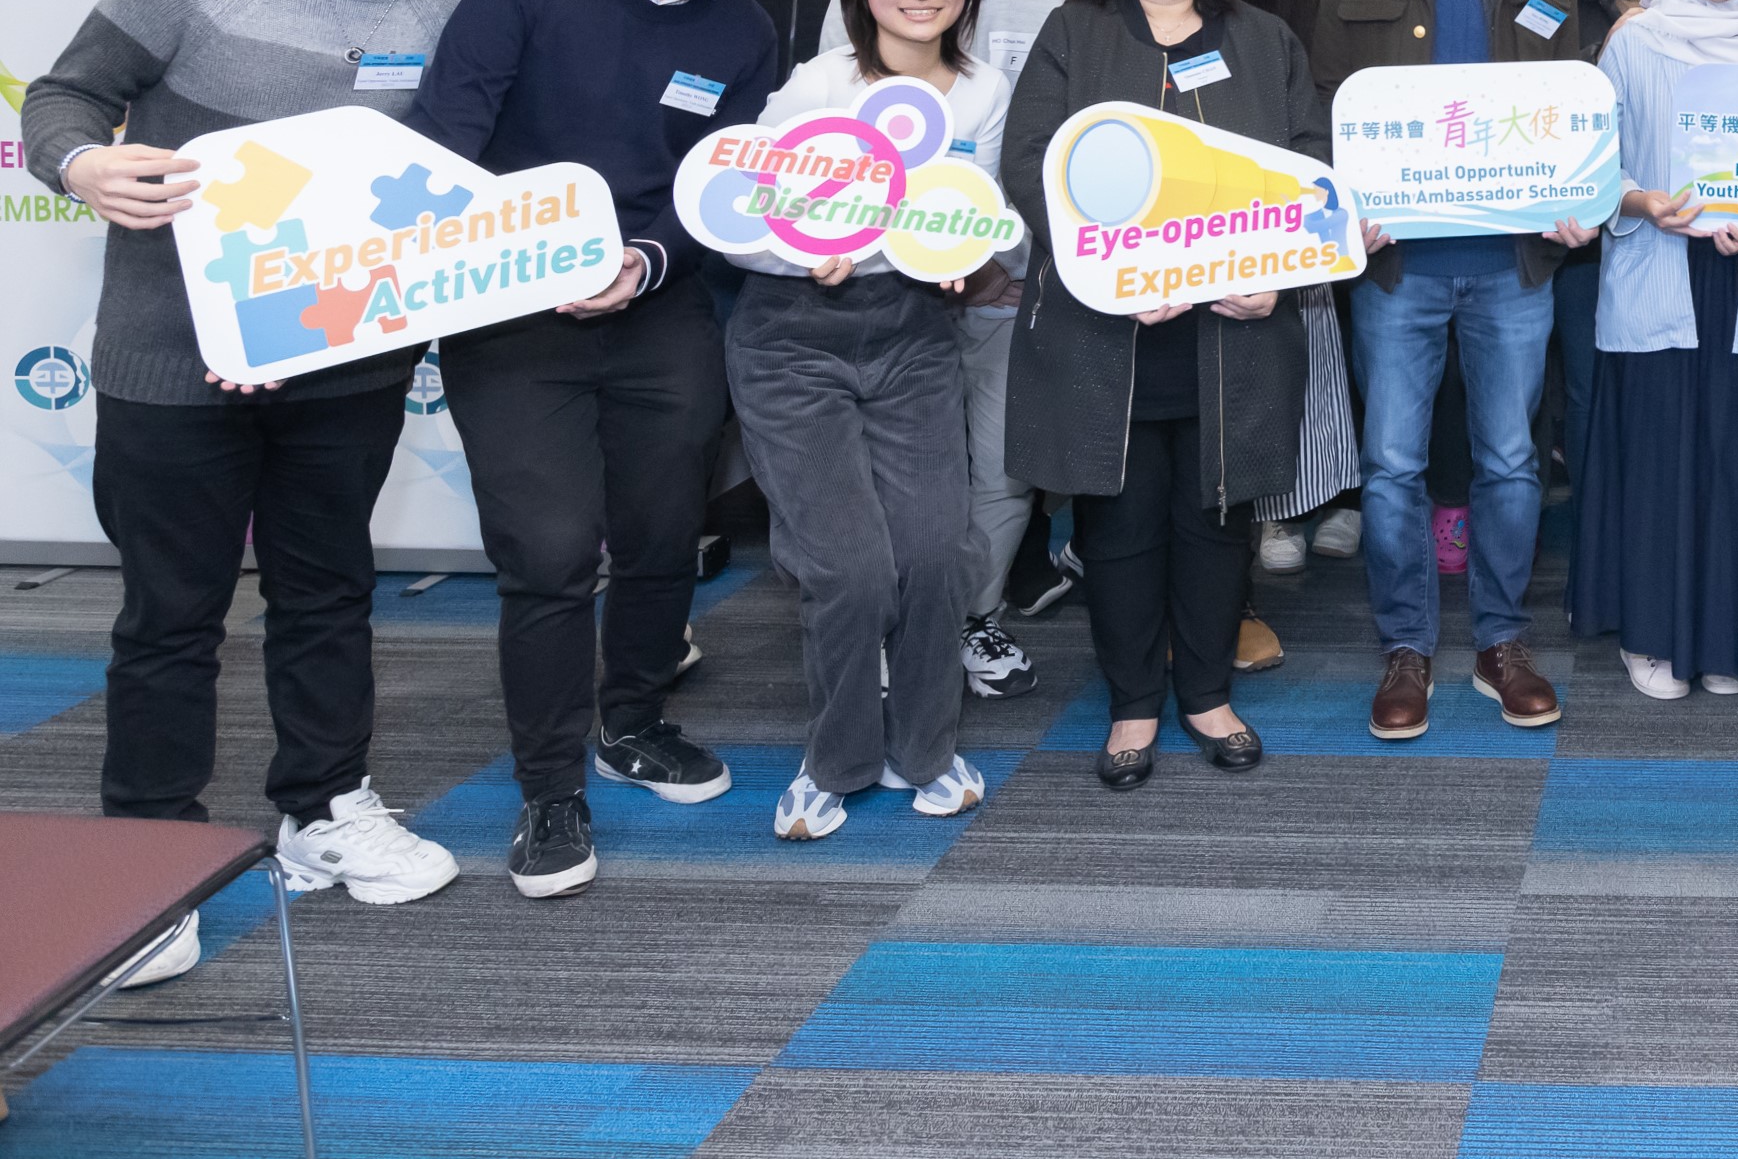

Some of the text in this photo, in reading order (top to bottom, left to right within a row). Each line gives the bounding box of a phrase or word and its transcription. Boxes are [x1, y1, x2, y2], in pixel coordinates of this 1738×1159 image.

[1010, 56, 1018, 65] F
[1339, 100, 1611, 157] 平等機會 青年大使 計劃
[709, 137, 893, 183] Eliminate
[1401, 162, 1557, 184] Equal Opportunity
[746, 187, 1016, 240] Discrimination
[1362, 183, 1595, 206] Youth Ambassador Scheme
[251, 183, 580, 296] Experiential
[1076, 201, 1302, 260] Eye-opening
[363, 235, 606, 323] Activities
[1115, 243, 1337, 299] Experiences
